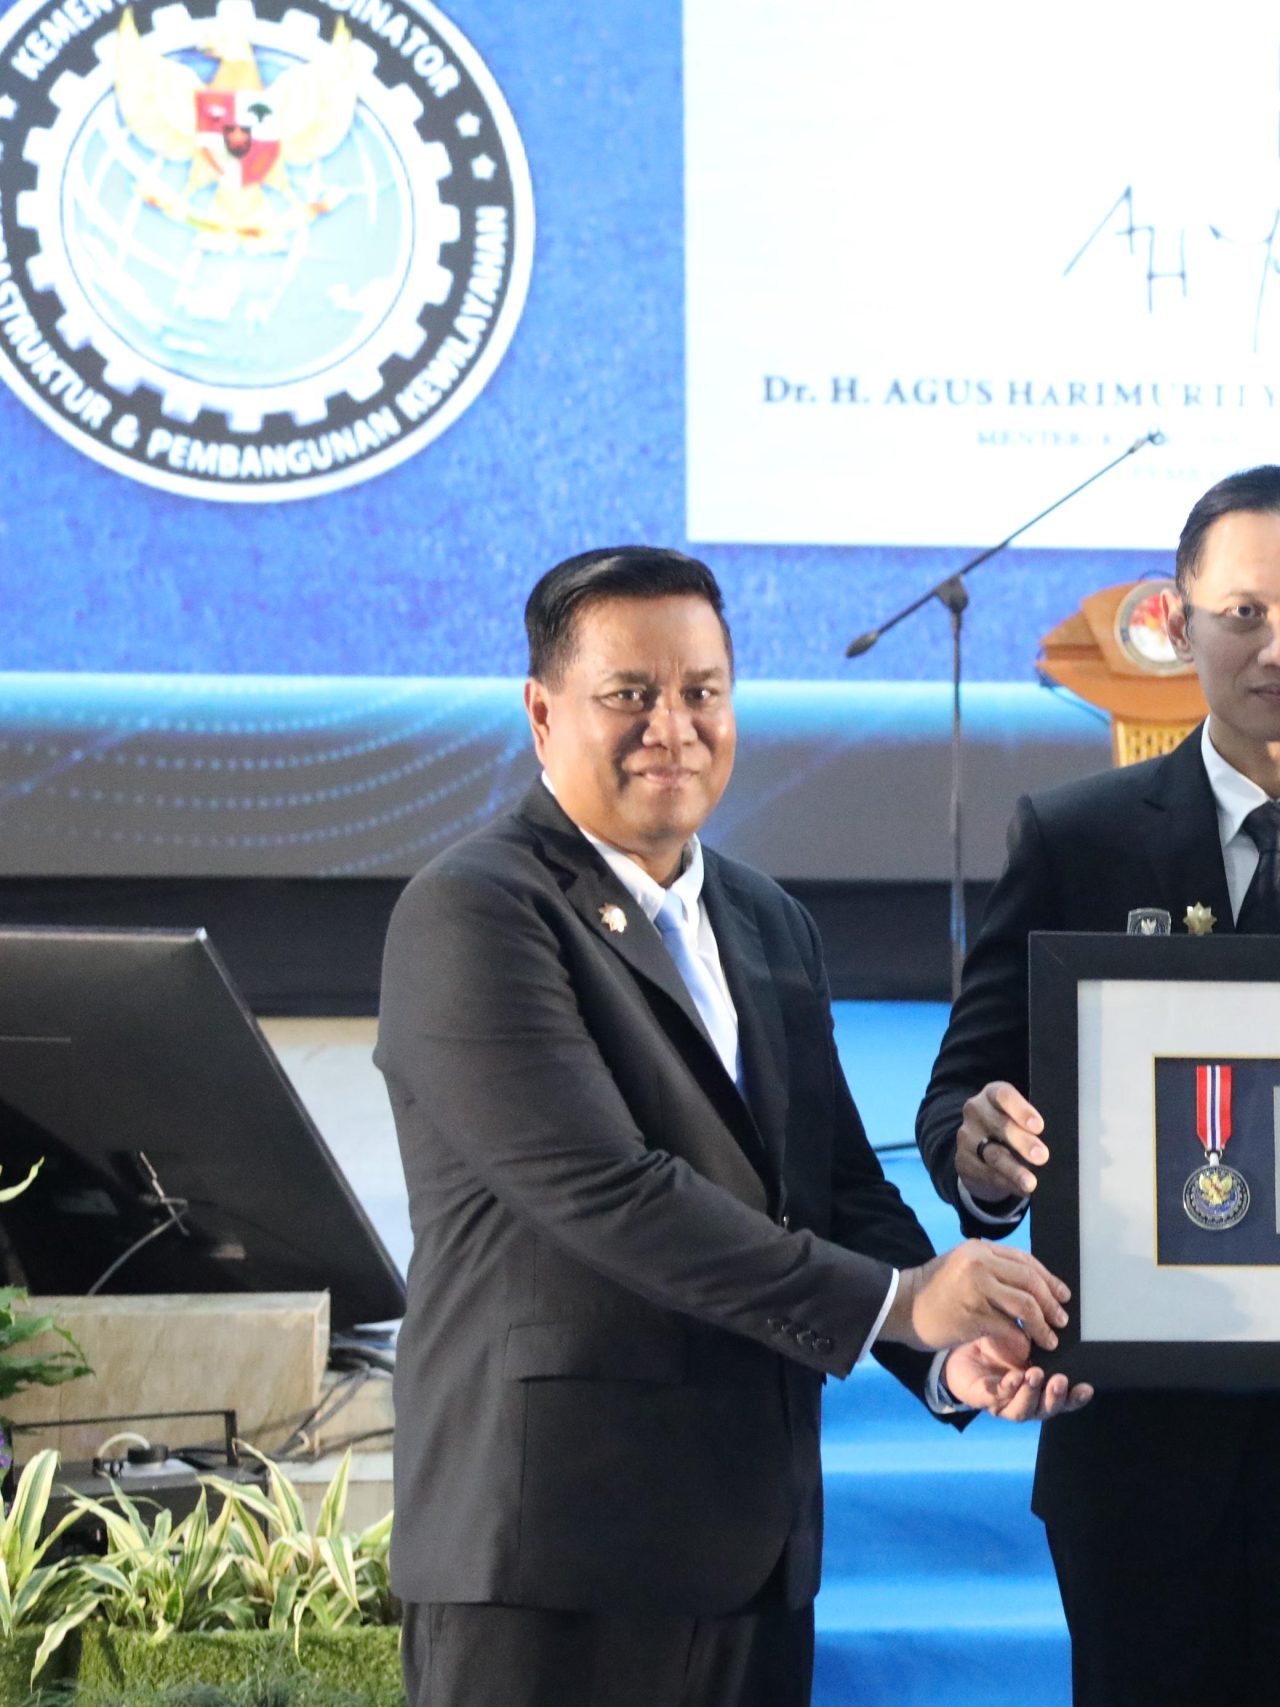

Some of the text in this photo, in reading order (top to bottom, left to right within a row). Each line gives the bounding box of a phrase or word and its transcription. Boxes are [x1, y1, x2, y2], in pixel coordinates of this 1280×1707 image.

[11, 0, 127, 81] KEMEN
[110, 414, 141, 448] &
[146, 407, 400, 479] PEMBANGUNAN
[395, 205, 509, 421] KEWILAYAHAN
[760, 372, 819, 406] Dr.
[829, 372, 872, 406] H.
[882, 377, 994, 407] AGUS
